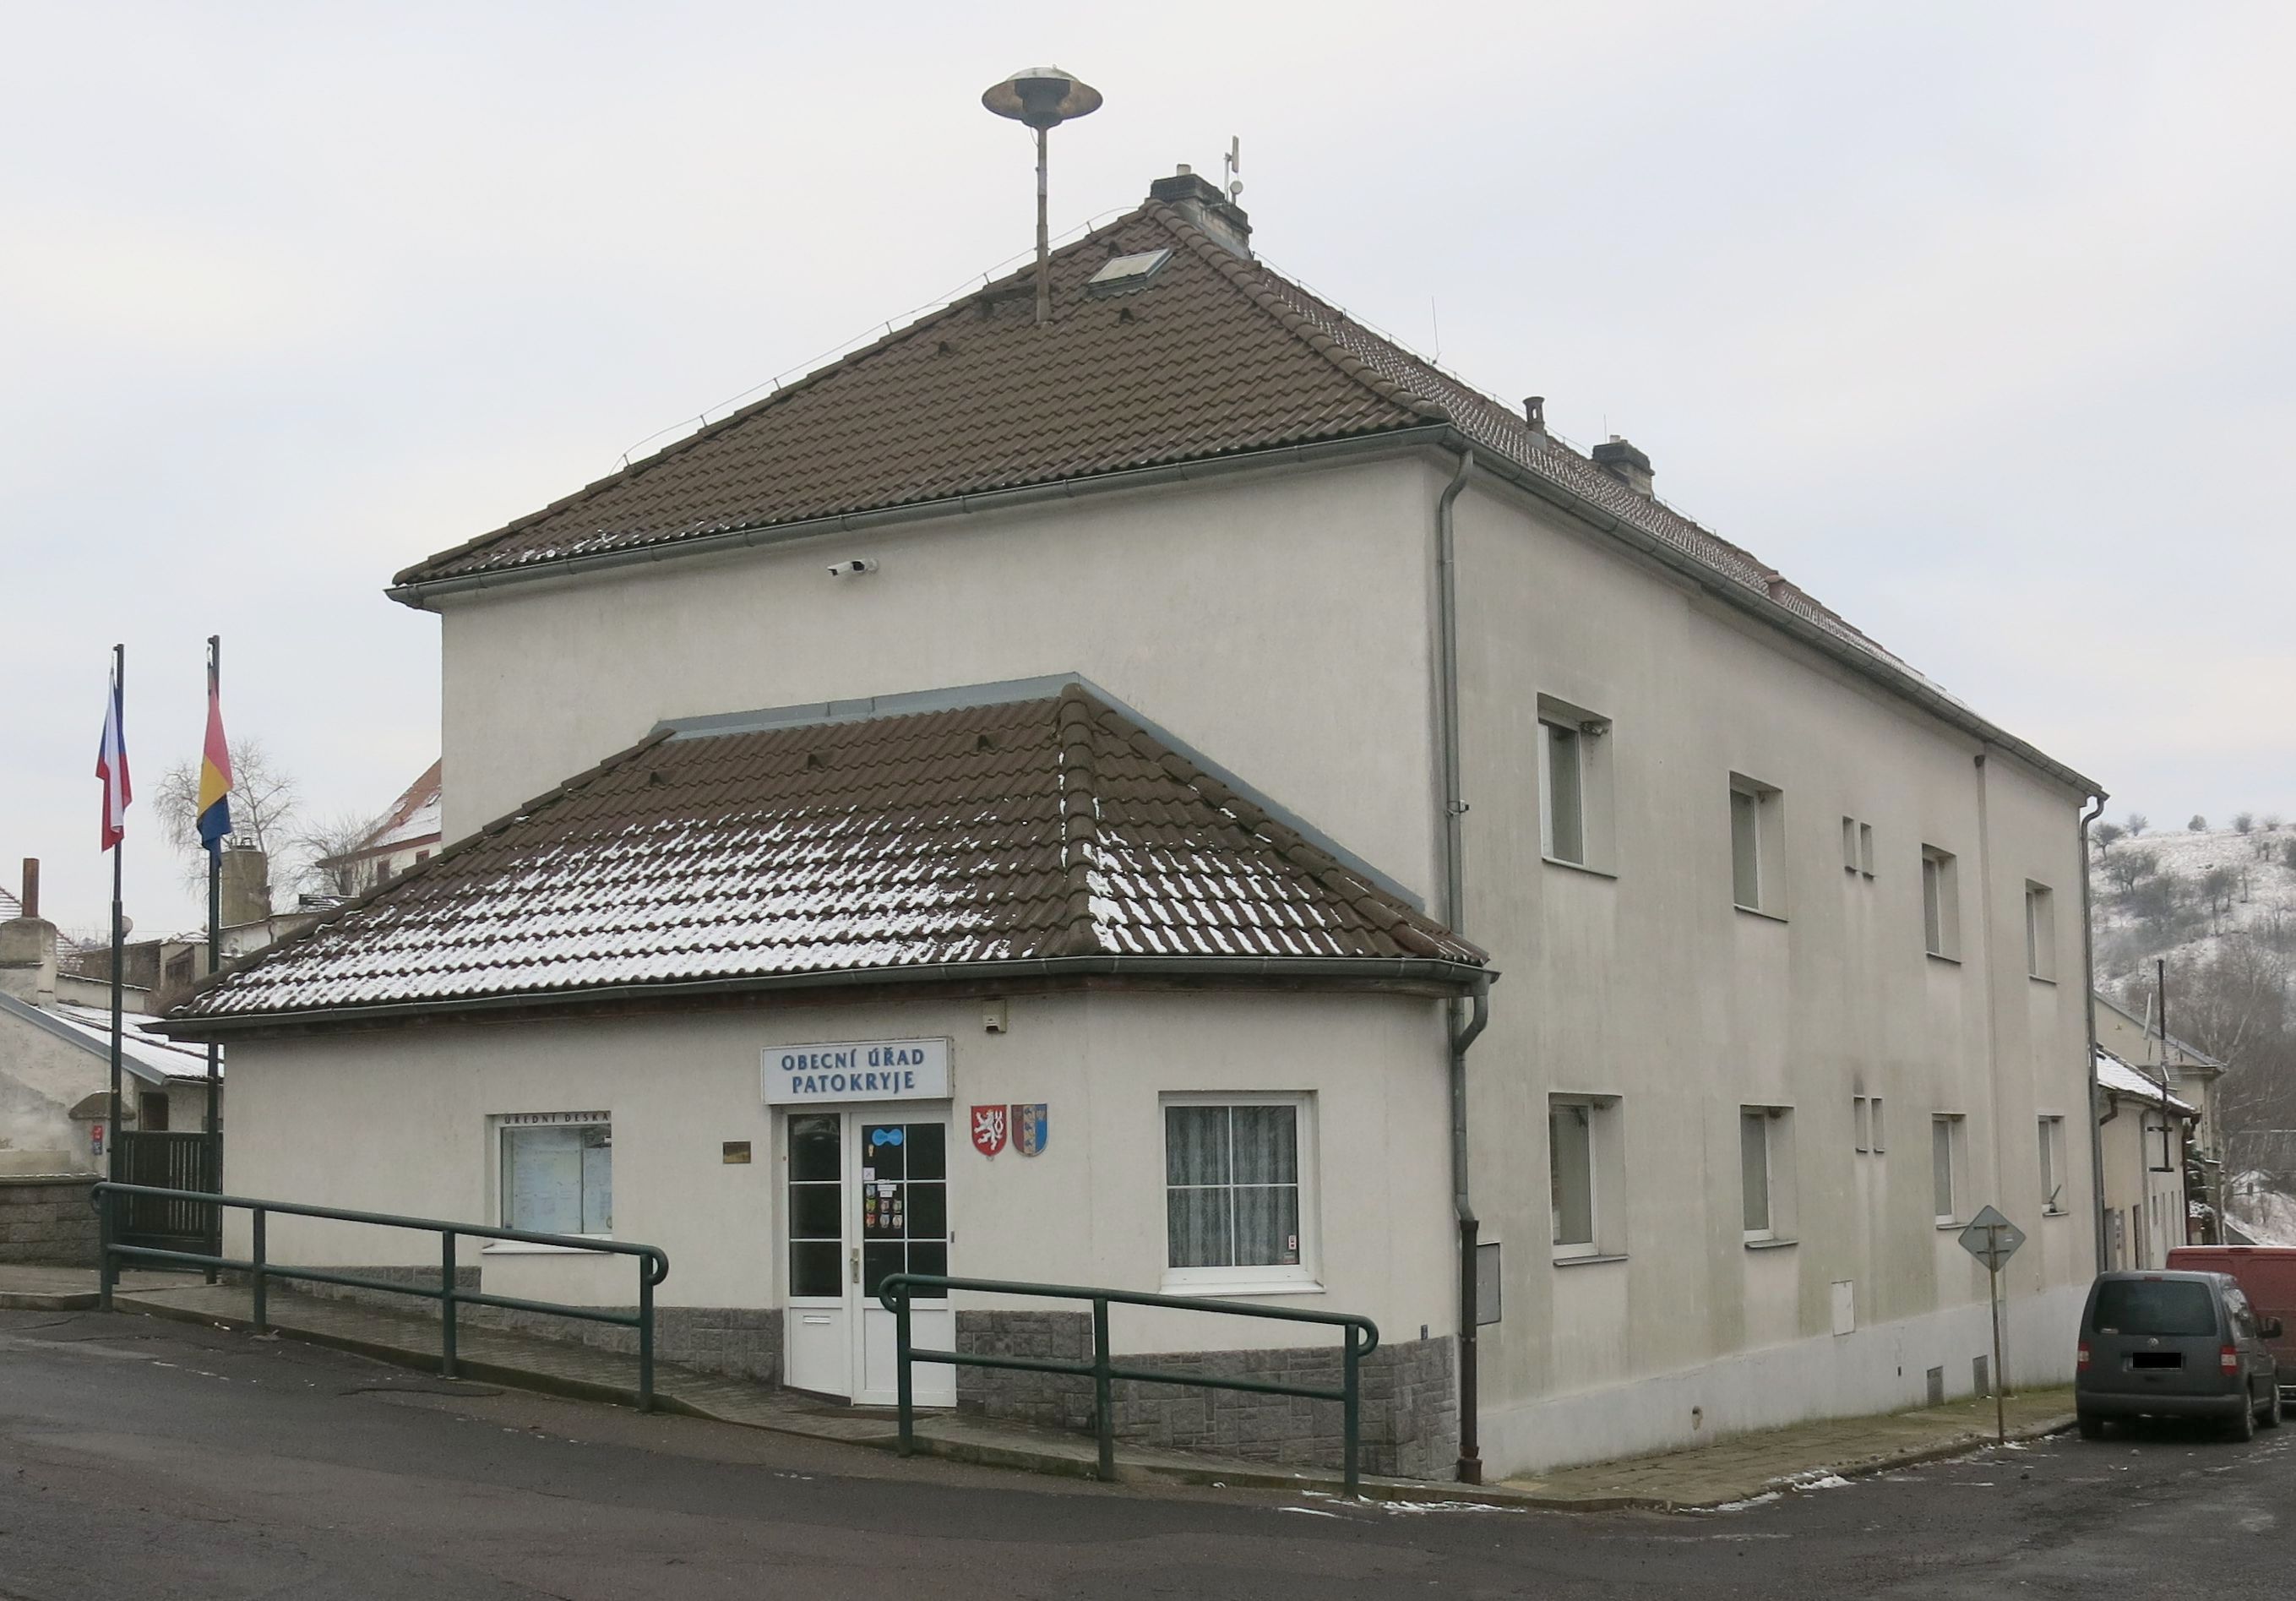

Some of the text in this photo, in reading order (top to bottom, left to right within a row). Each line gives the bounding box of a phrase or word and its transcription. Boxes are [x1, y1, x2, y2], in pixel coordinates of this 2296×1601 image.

[781, 1047, 924, 1070] OBECNÍ ÚŘAD
[792, 1071, 915, 1094] PATOKRYJE
[565, 1113, 608, 1122] DESKA
